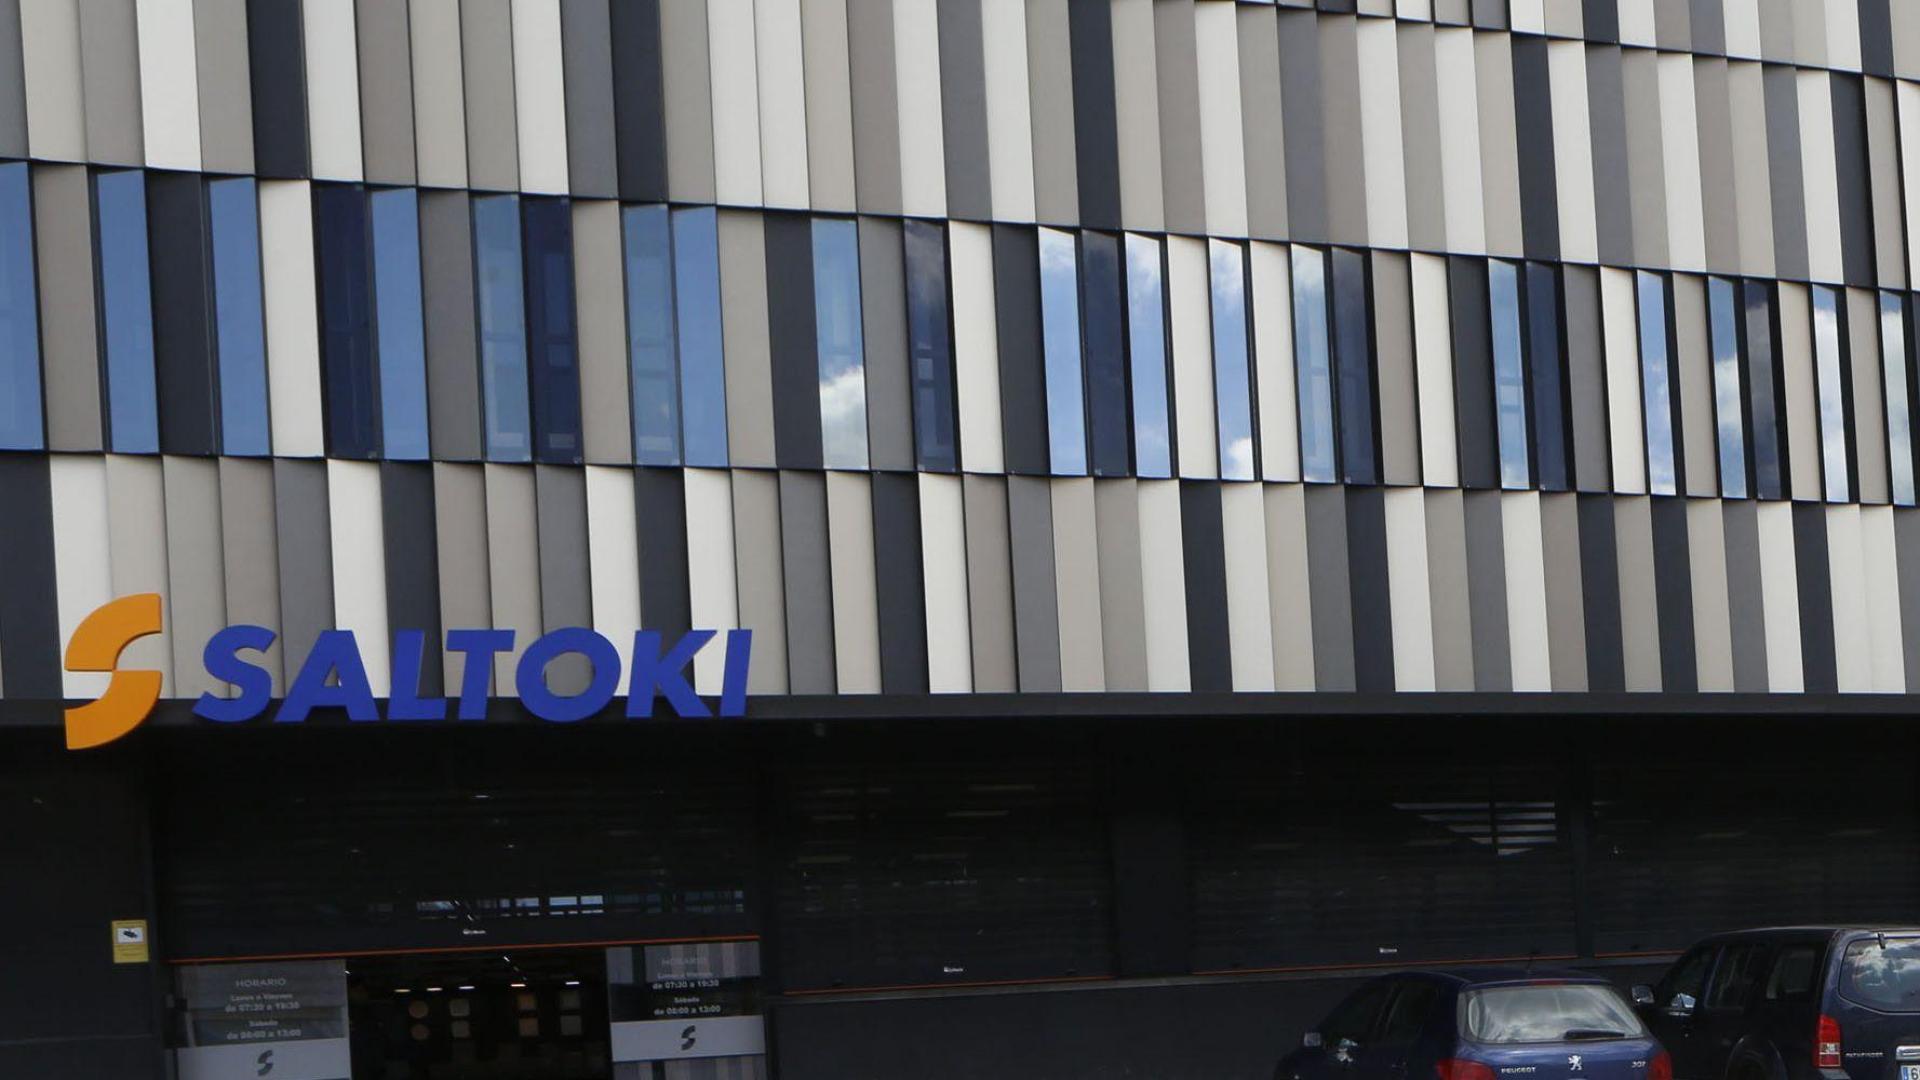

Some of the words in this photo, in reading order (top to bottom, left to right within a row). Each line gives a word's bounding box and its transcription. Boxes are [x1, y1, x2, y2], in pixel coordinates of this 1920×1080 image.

[192, 624, 753, 722] SALTOKI
[235, 978, 287, 988] HORARIO
[1631, 1060, 1647, 1068] 307
[1501, 1066, 1537, 1074] PEUGEOT
